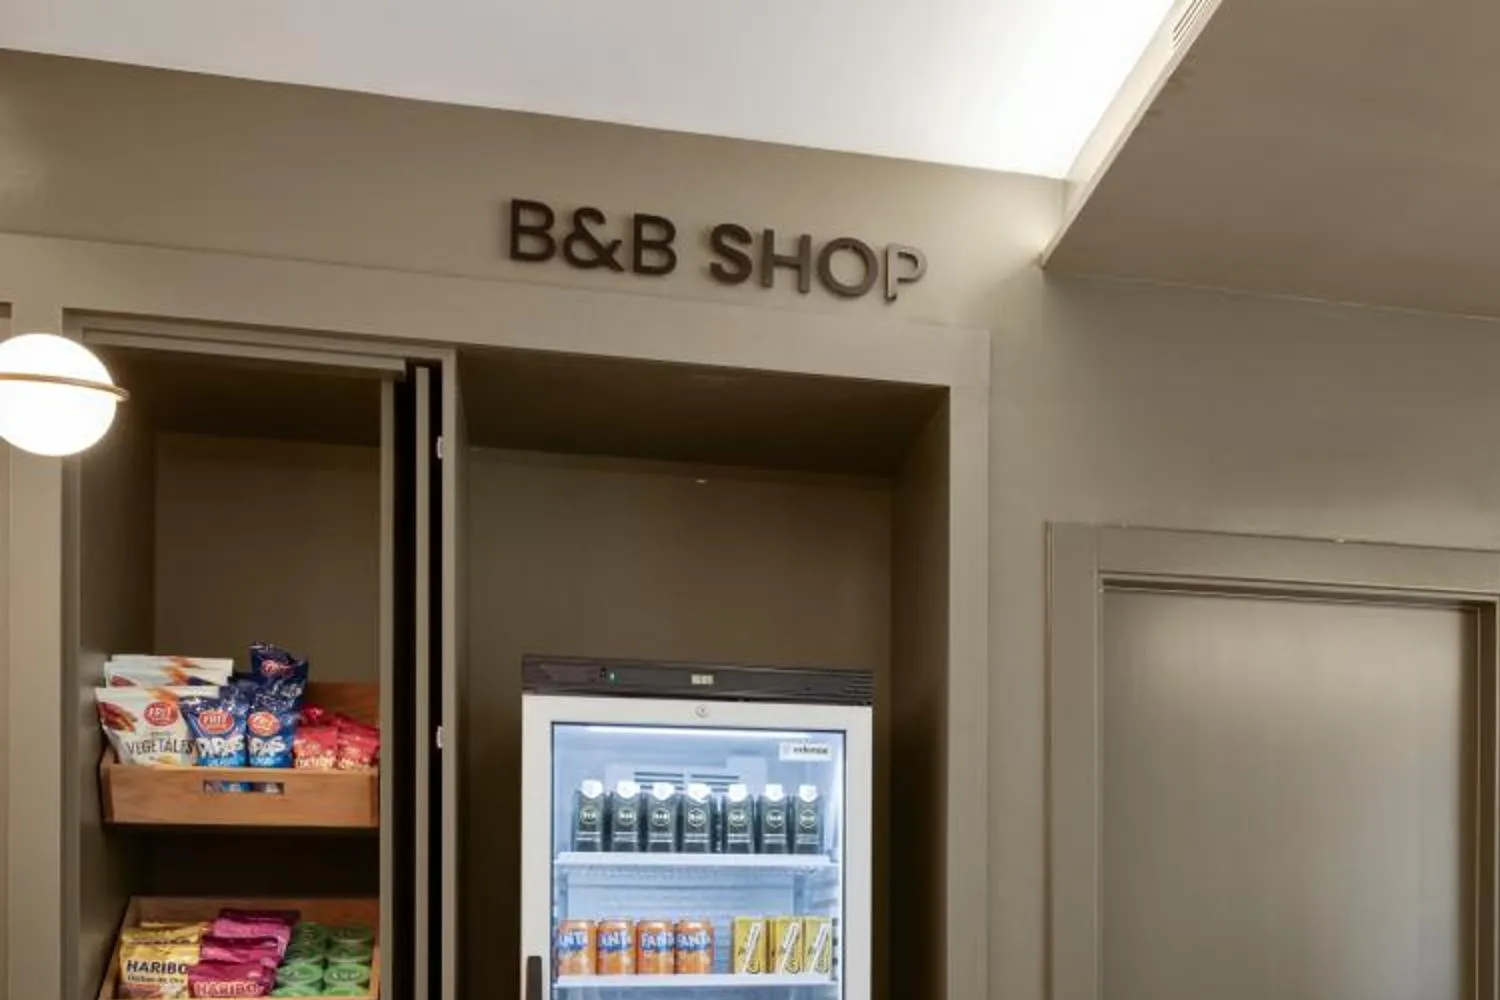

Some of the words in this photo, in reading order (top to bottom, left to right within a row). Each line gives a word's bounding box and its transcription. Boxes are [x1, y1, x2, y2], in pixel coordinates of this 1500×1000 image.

[509, 198, 677, 277] B&B
[709, 223, 928, 303] SHOP
[127, 959, 188, 975] HARIBO
